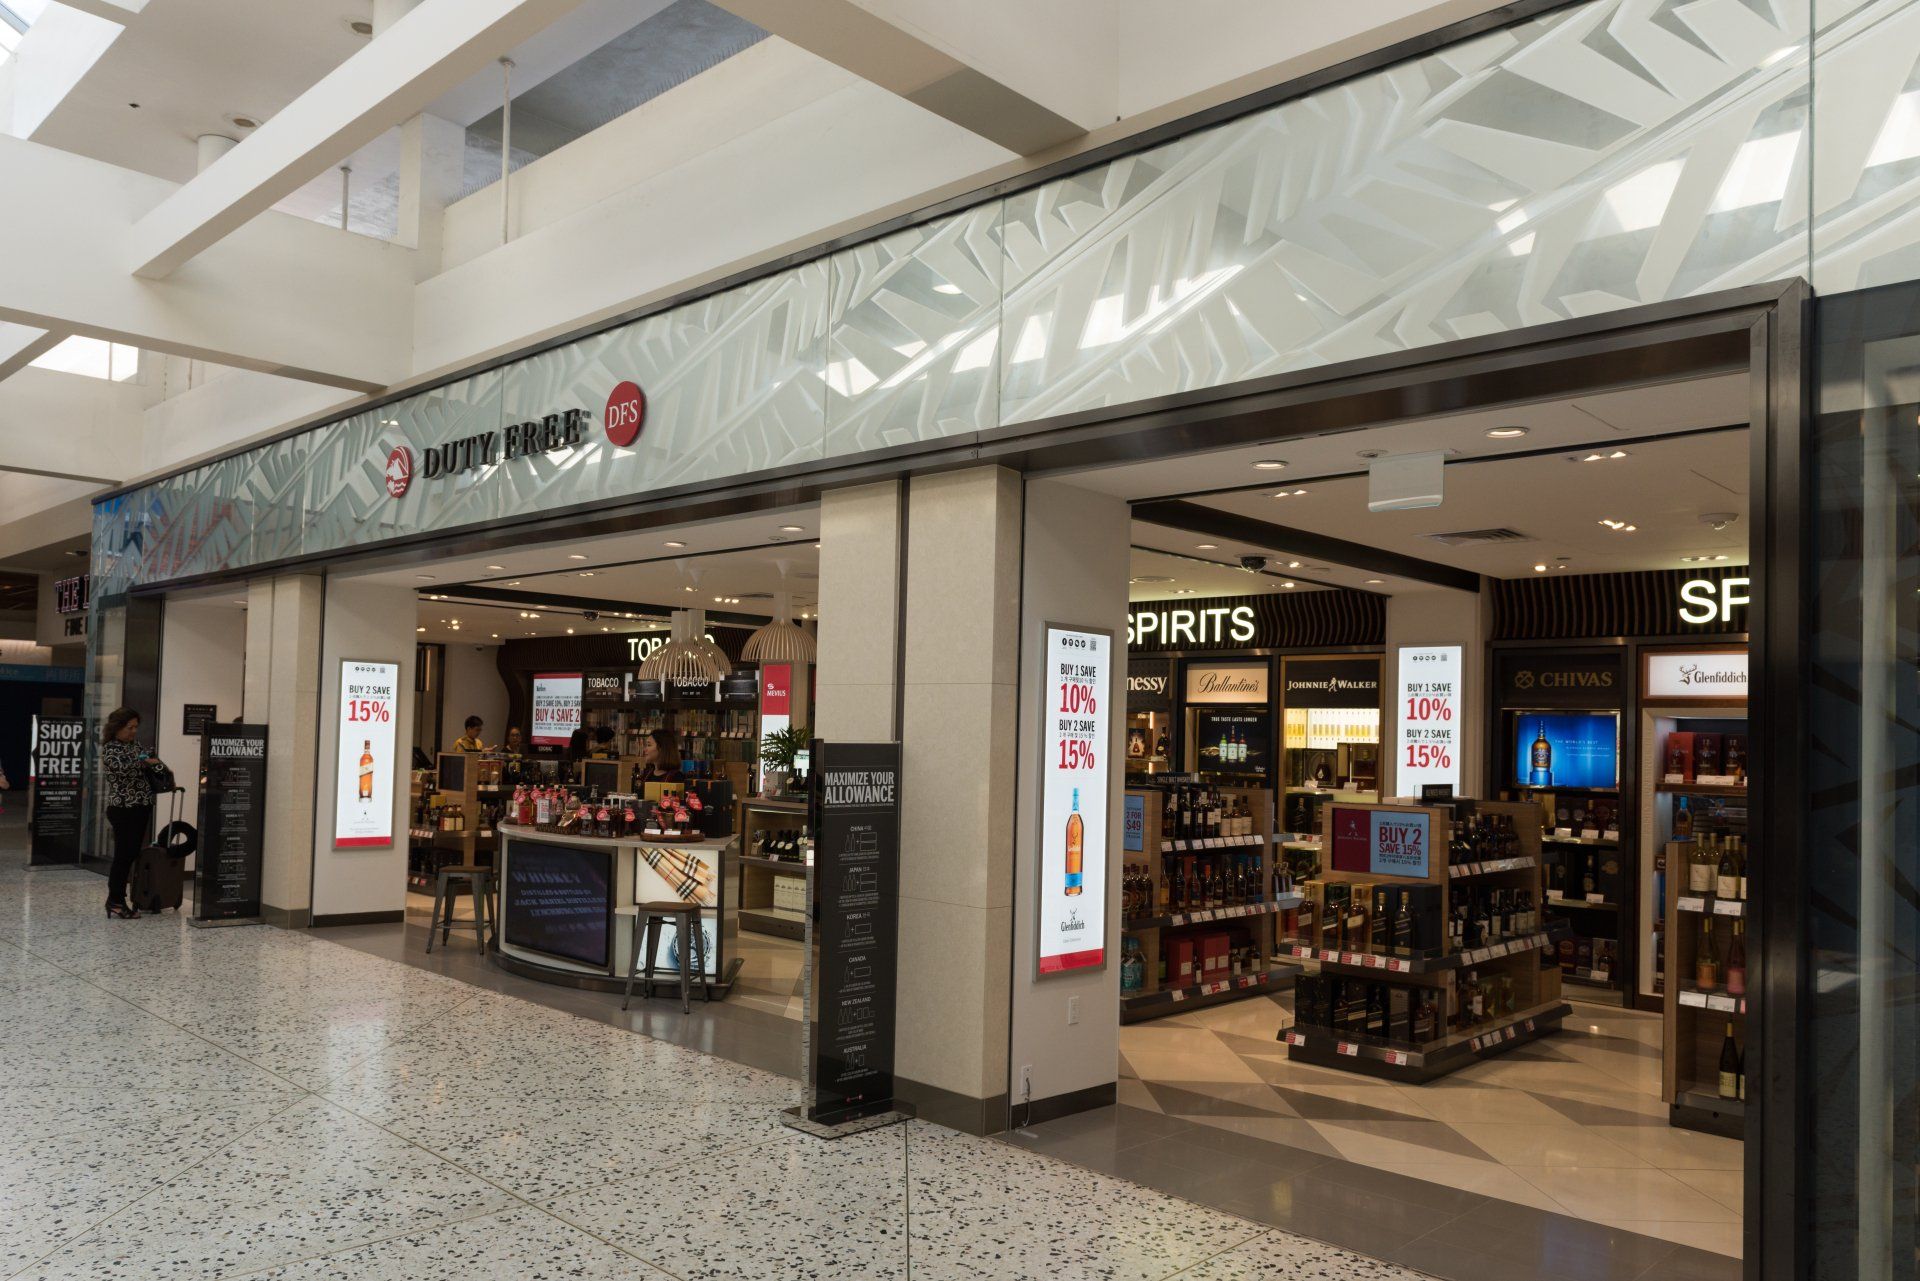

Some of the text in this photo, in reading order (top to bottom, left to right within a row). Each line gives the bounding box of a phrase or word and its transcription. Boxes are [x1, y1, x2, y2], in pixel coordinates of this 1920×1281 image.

[608, 399, 639, 429] DFS
[422, 408, 585, 479] DUTY FREE
[1060, 663, 1097, 678] BUY 1 SAVE
[1694, 670, 1747, 684] Glenfiddich
[588, 677, 619, 688] TOBACCO
[673, 675, 709, 688] TOBACCO
[1198, 672, 1261, 694] Ballantine's
[1286, 679, 1378, 691] JOHNNIE WALKER
[1407, 682, 1452, 692] BUY 1 SAVE
[1540, 671, 1613, 688] CHIVAS
[349, 684, 390, 695] BUY 2 SAVE
[1060, 682, 1097, 715] 10%
[348, 699, 390, 722] 15%
[535, 708, 582, 722] BUY 4 SAVE 2
[1406, 697, 1452, 721] 10%
[40, 724, 83, 740] SHOP
[1059, 719, 1095, 732] BUY 2 SAVE
[1406, 729, 1451, 739] BUY 2 SAVE
[39, 740, 82, 757] DUTY
[211, 738, 265, 747] MAXIMIZE YOUR
[210, 746, 264, 757] ALLOWANCE
[1058, 739, 1095, 770] 15%
[1406, 744, 1451, 768] 15%
[38, 757, 81, 774] FREE
[824, 771, 895, 786] MAXIMIZE YOUR
[824, 785, 895, 804] ALLOWANCE
[1126, 819, 1141, 832] $49
[1379, 826, 1422, 845] BUY 2
[1379, 842, 1422, 856] SAVE 15%
